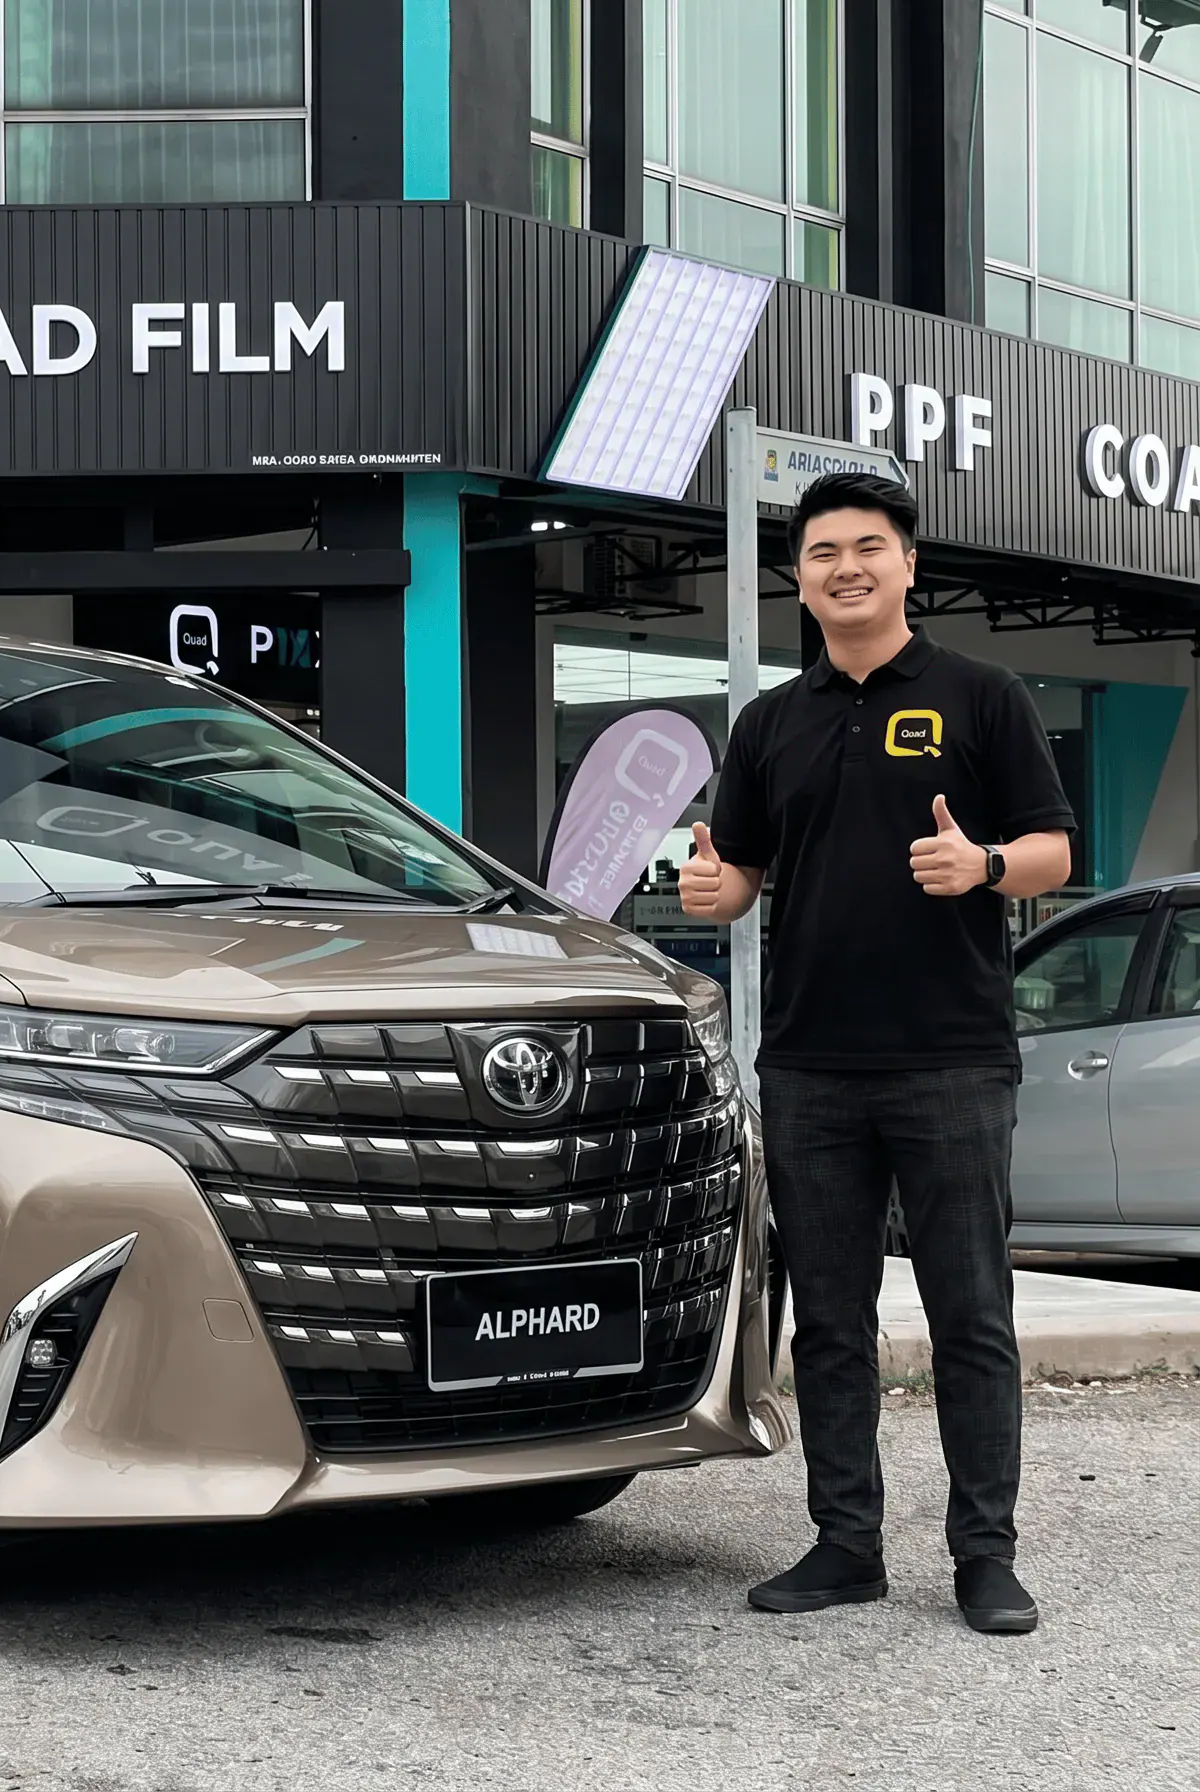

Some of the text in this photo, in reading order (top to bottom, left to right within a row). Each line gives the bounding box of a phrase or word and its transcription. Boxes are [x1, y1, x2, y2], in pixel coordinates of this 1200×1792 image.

[132, 301, 345, 374] FILM
[851, 372, 992, 471] PPF
[183, 632, 207, 646] Quad
[474, 1302, 600, 1341] ALPHARD
